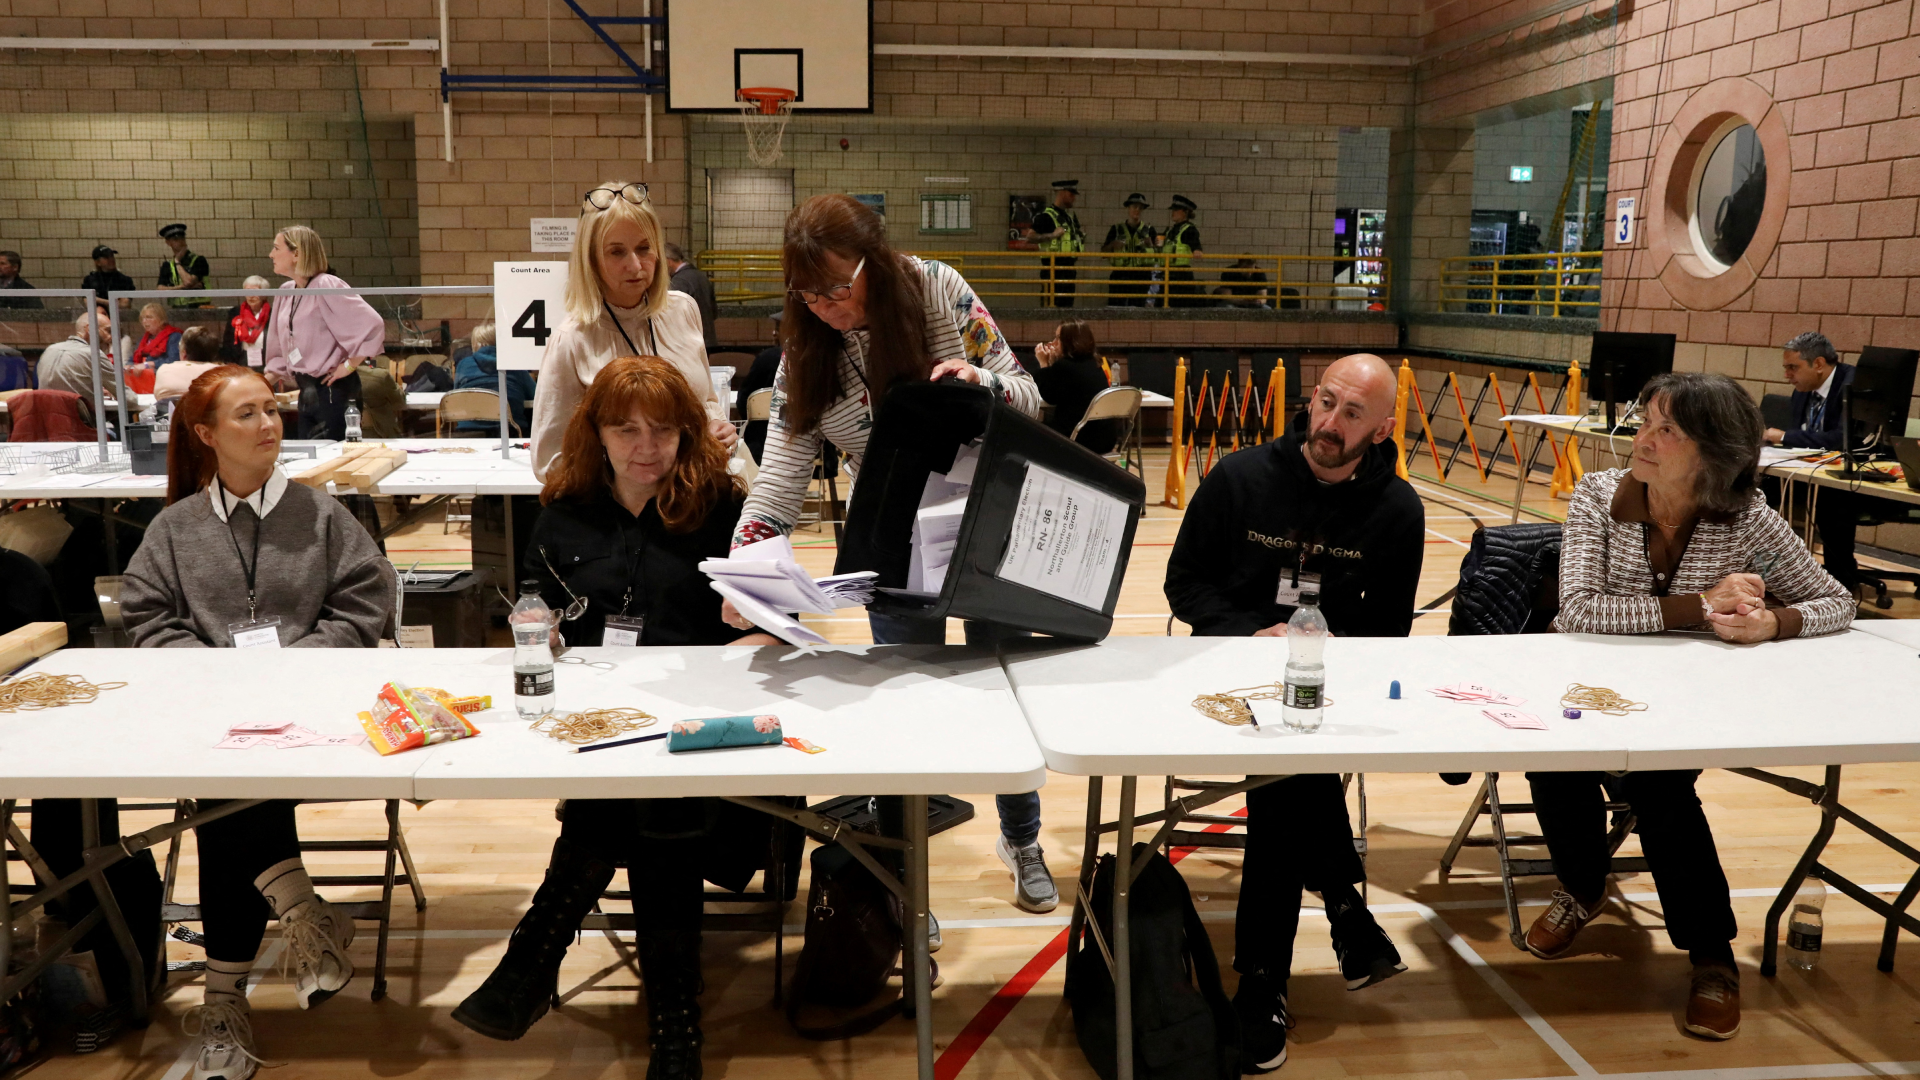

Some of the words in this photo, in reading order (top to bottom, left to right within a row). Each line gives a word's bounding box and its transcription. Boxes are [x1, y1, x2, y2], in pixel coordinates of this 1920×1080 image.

[1619, 214, 1629, 241] 3
[512, 299, 551, 346] 4
[1021, 478, 1032, 505] Election
[1036, 528, 1048, 551] RN-
[1043, 508, 1052, 524] 86
[1047, 523, 1067, 576] Northallerton
[1063, 497, 1072, 521] Scout
[1056, 557, 1064, 573] and
[1060, 532, 1072, 556] Guide
[1068, 504, 1079, 530] Group
[1247, 530, 1310, 551] DRAGOS
[381, 726, 401, 748] HARIBO
